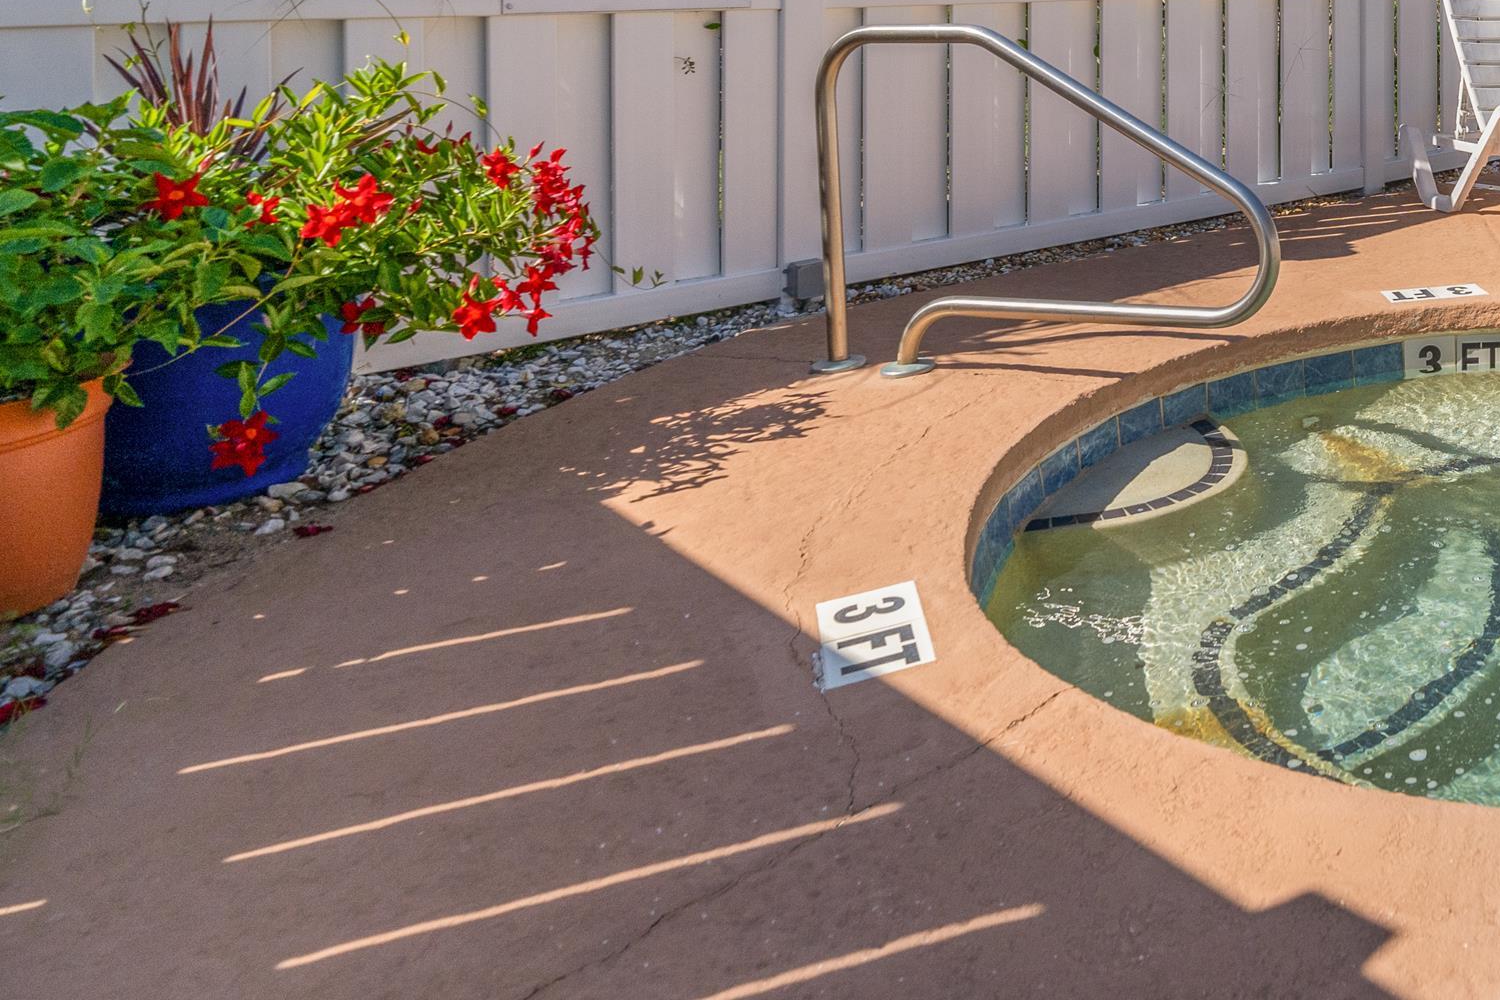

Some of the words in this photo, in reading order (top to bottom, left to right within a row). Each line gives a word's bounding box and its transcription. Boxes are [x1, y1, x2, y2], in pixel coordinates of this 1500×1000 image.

[1392, 288, 1436, 301] FT
[1446, 286, 1473, 296] 3
[1418, 345, 1442, 374] 3
[833, 596, 905, 624] 3
[837, 623, 921, 676] FT
